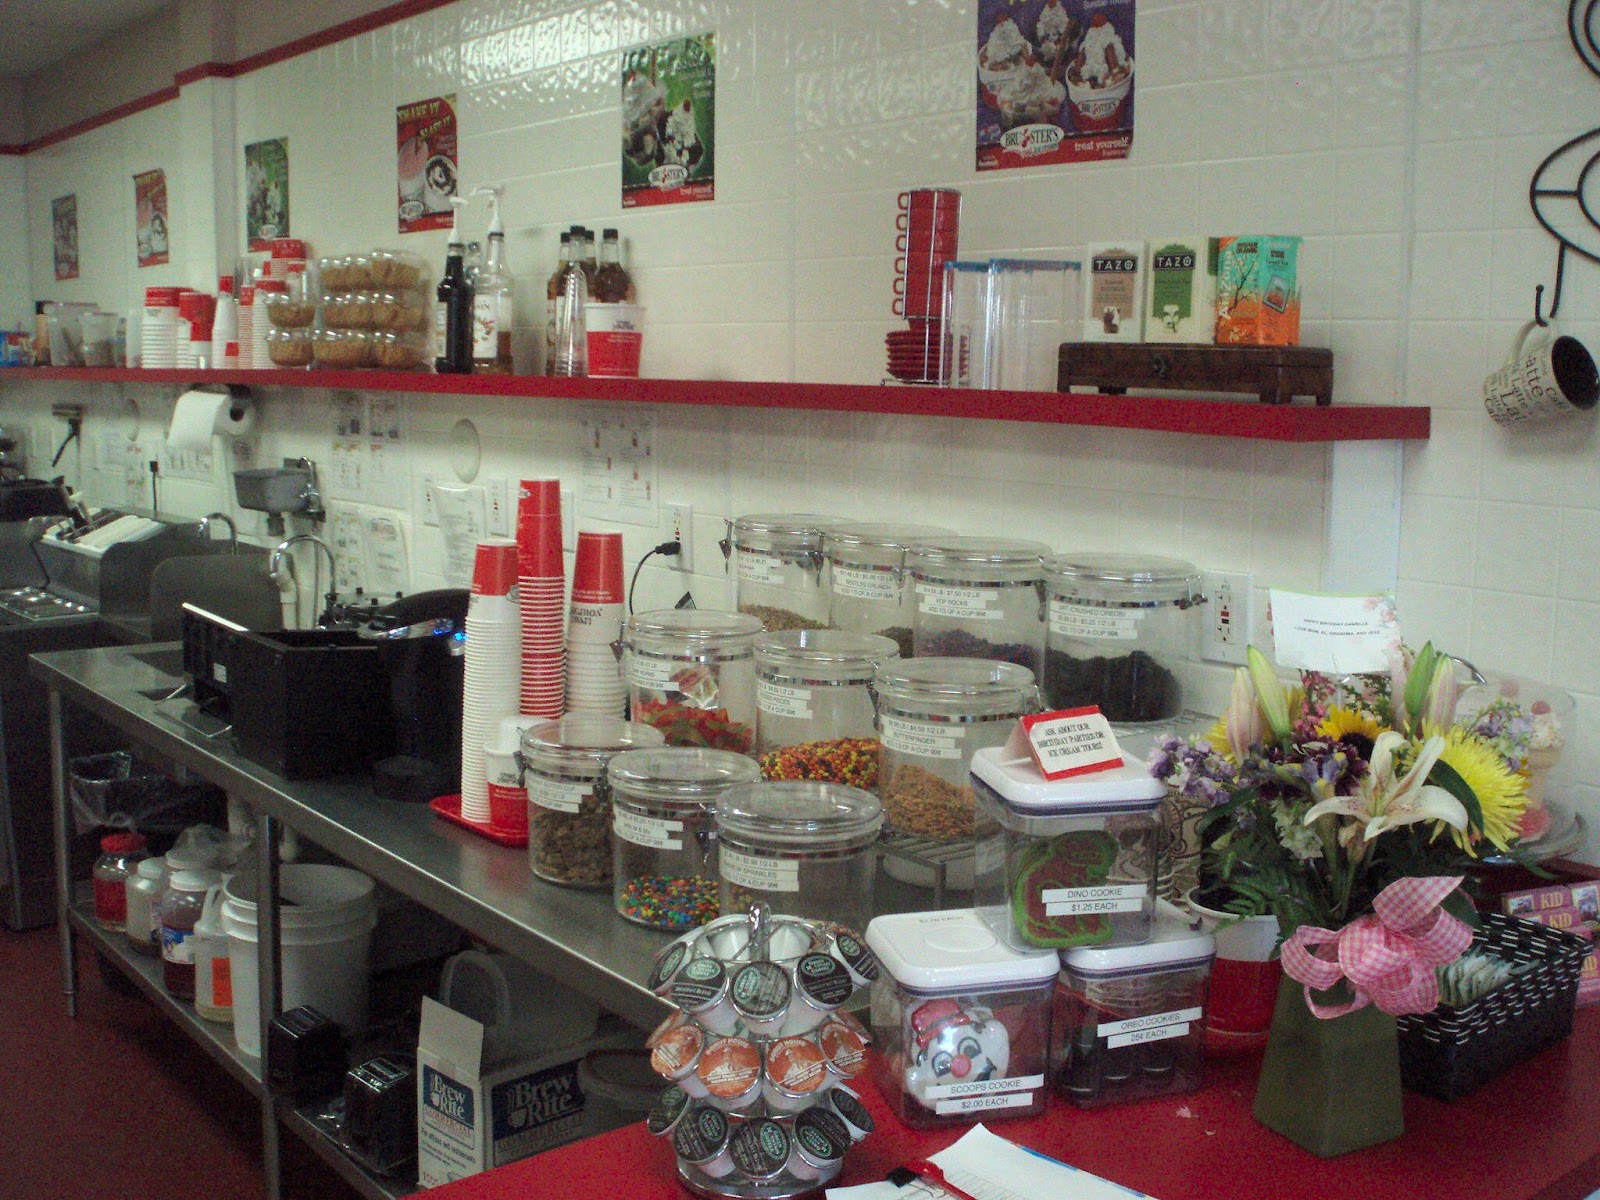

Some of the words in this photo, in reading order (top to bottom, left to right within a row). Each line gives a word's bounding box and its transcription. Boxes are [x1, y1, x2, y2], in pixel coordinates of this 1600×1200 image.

[1096, 137, 1129, 151] yourself
[1096, 260, 1133, 270] TAZO
[1157, 256, 1192, 267] TAZO
[1045, 728, 1056, 737] ASK
[1058, 725, 1077, 736] ABOUT
[1077, 722, 1091, 731] OUR
[893, 731, 936, 745] BUTTERFINGER
[1036, 737, 1068, 749] BIRTHDAY
[1068, 732, 1096, 744] PARTIES
[915, 746, 929, 754] CUP
[1047, 748, 1059, 758] ICE
[1059, 745, 1081, 756] CREAM
[743, 868, 777, 879] SPRINKLES
[1067, 889, 1088, 899] DINO
[1090, 888, 1123, 897] COOKIE
[1071, 903, 1093, 912] $1.25
[1094, 902, 1118, 911] EACH
[1121, 1020, 1144, 1030] OREO
[1145, 1013, 1181, 1025] COOKIES
[1130, 1033, 1144, 1042] 25¢
[1145, 1029, 1168, 1039] EACH
[434, 1073, 466, 1104] Brew
[514, 1074, 573, 1106] Brew
[951, 1083, 987, 1094] SCOOPS
[988, 1079, 1021, 1090] COOKIE
[440, 1095, 465, 1120] Rite
[527, 1093, 573, 1127] Rite
[961, 1099, 984, 1109] $2.00
[985, 1097, 1009, 1106] EACH
